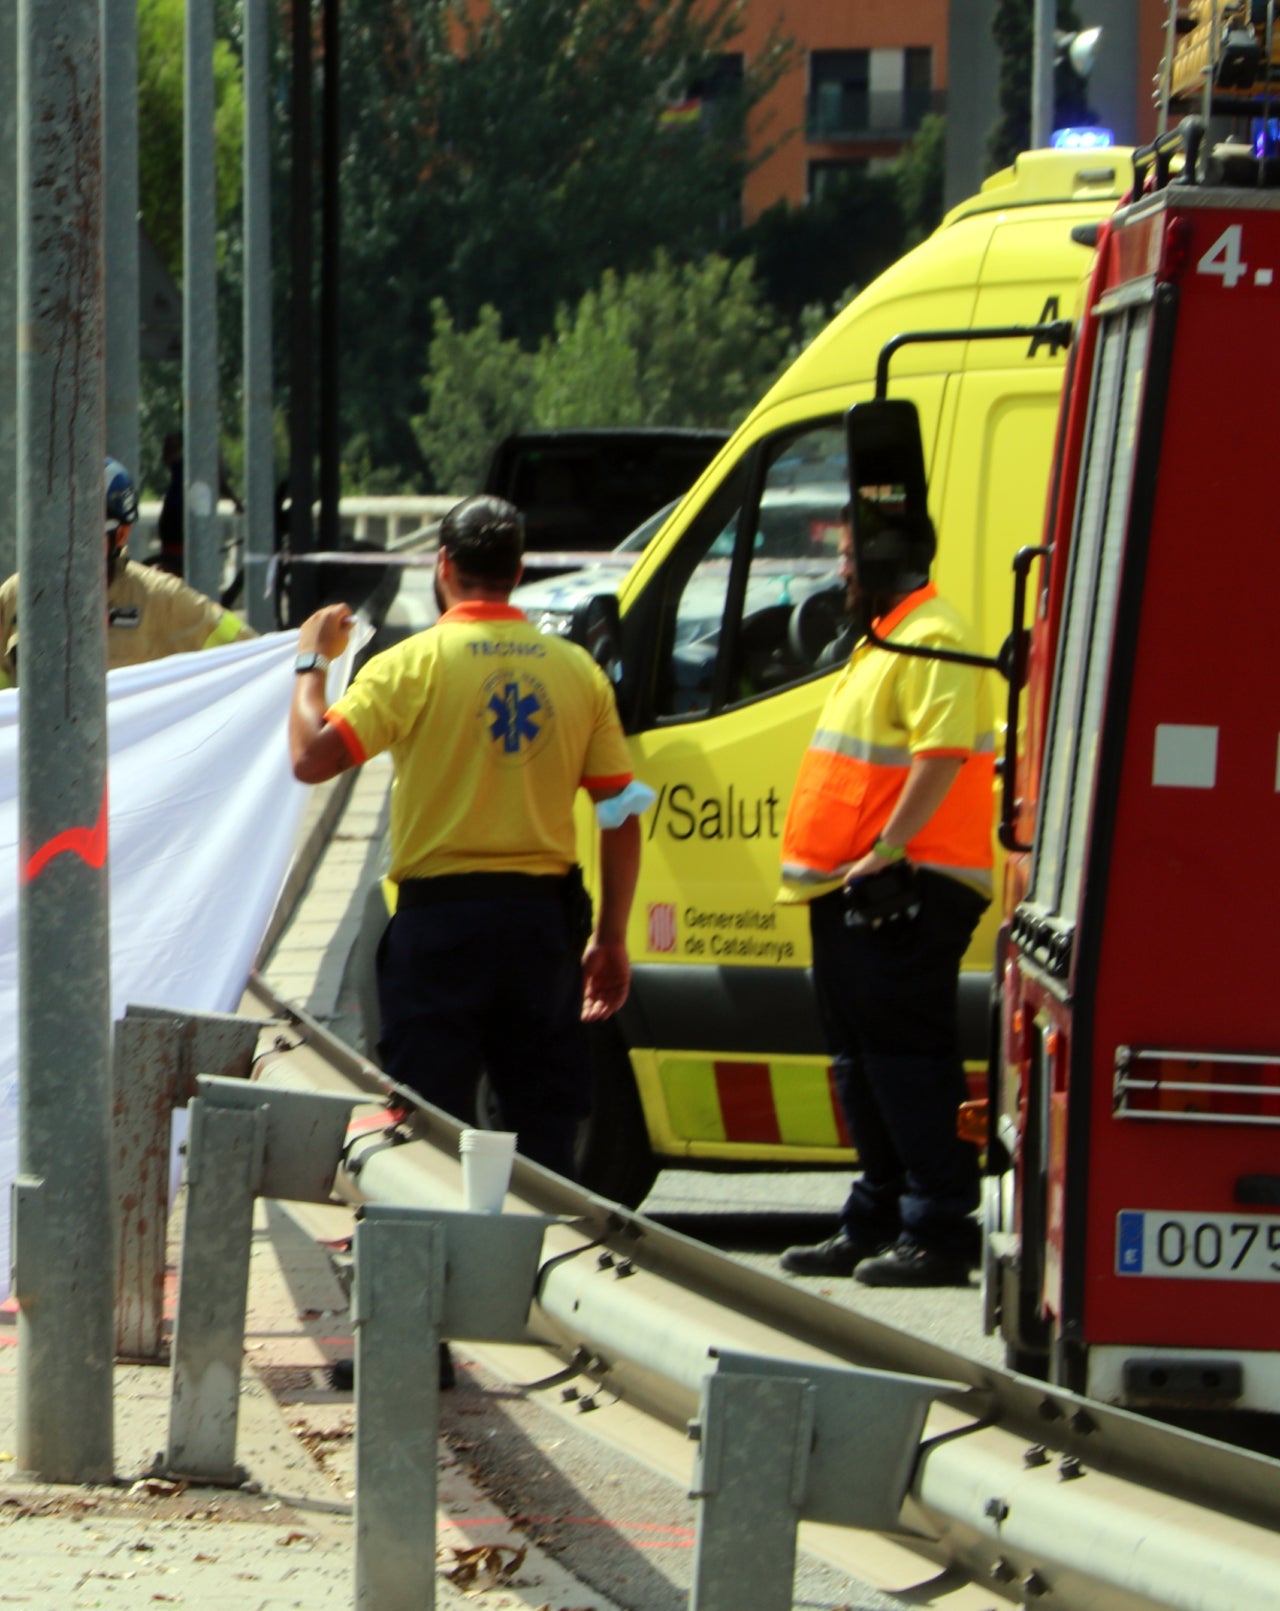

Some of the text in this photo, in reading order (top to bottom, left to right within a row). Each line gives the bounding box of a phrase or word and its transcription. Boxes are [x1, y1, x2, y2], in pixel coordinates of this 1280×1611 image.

[683, 906, 777, 930] Generalitat
[684, 934, 795, 962] de Catalunya
